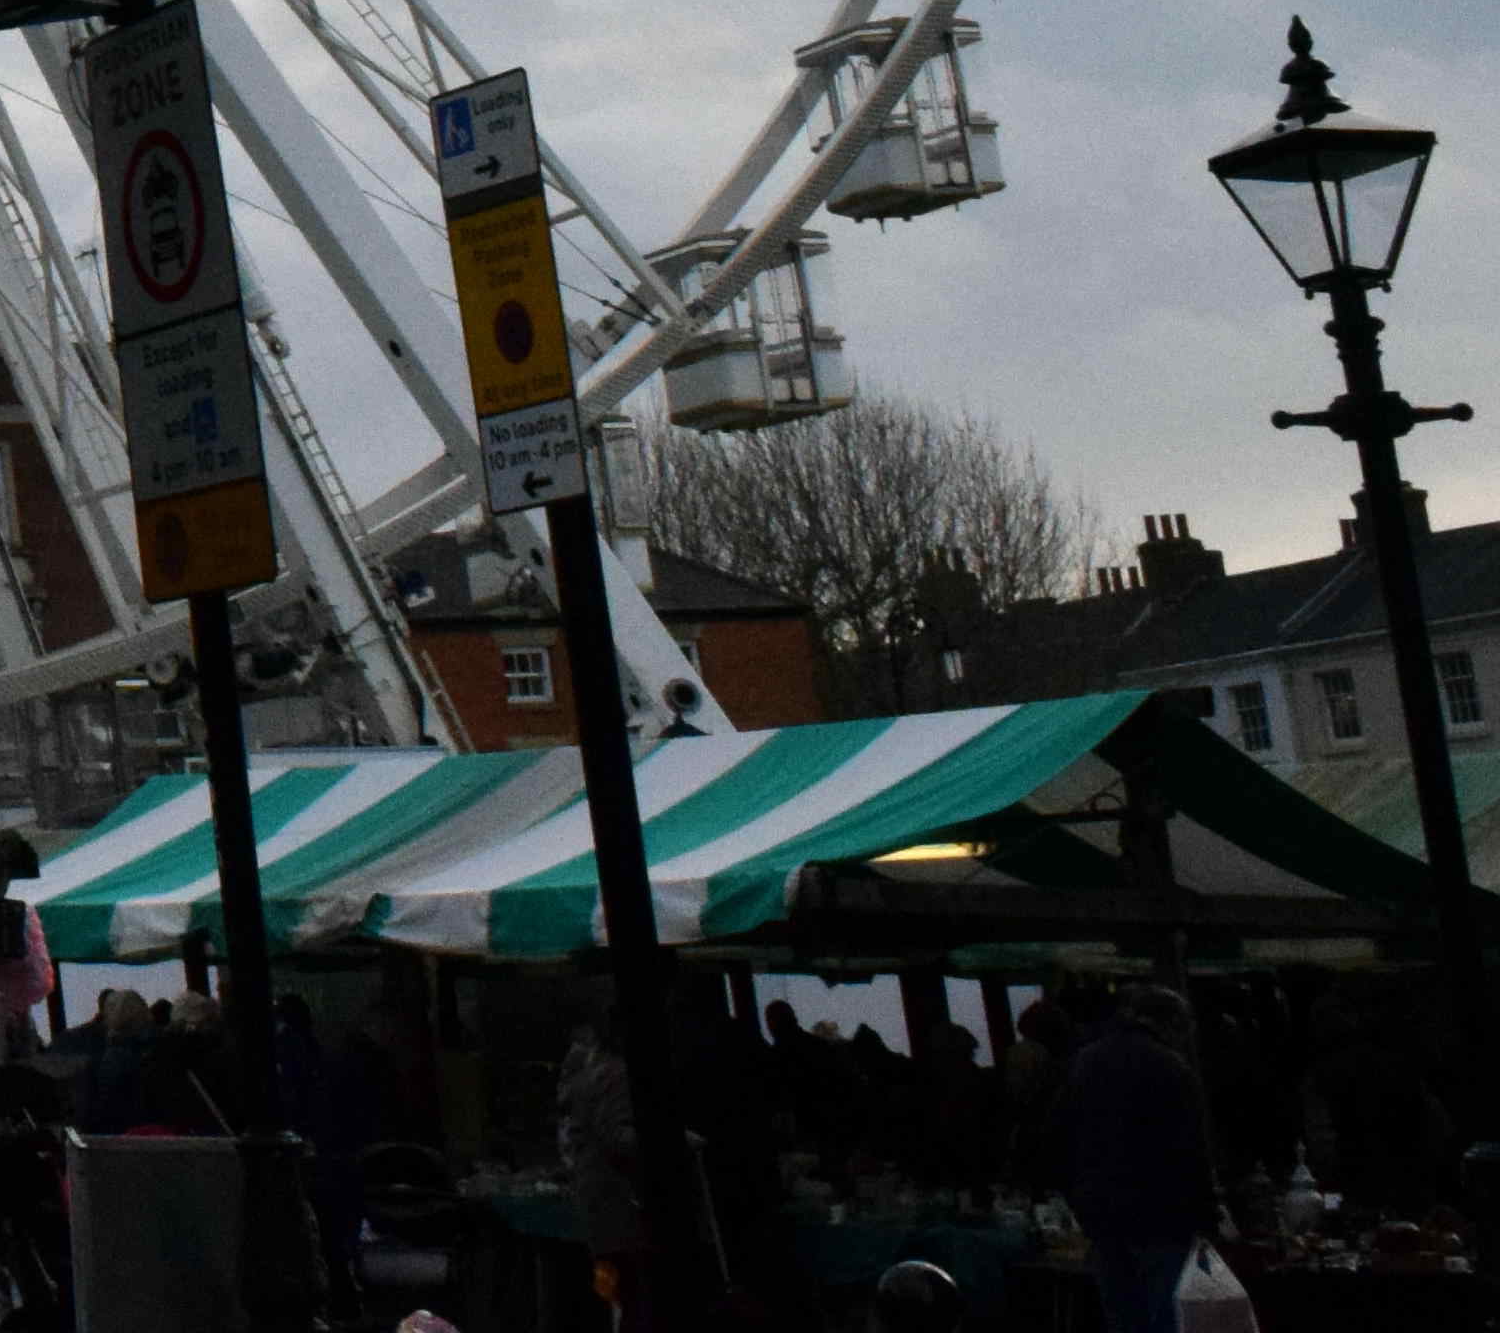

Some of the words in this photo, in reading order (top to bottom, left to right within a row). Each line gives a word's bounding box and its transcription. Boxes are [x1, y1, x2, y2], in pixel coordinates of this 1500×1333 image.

[110, 61, 184, 126] ZONE
[490, 427, 511, 444] No
[512, 414, 568, 438] loading
[489, 450, 506, 470] 10
[510, 449, 531, 467] am
[540, 441, 550, 459] 4
[554, 439, 576, 462] pm
